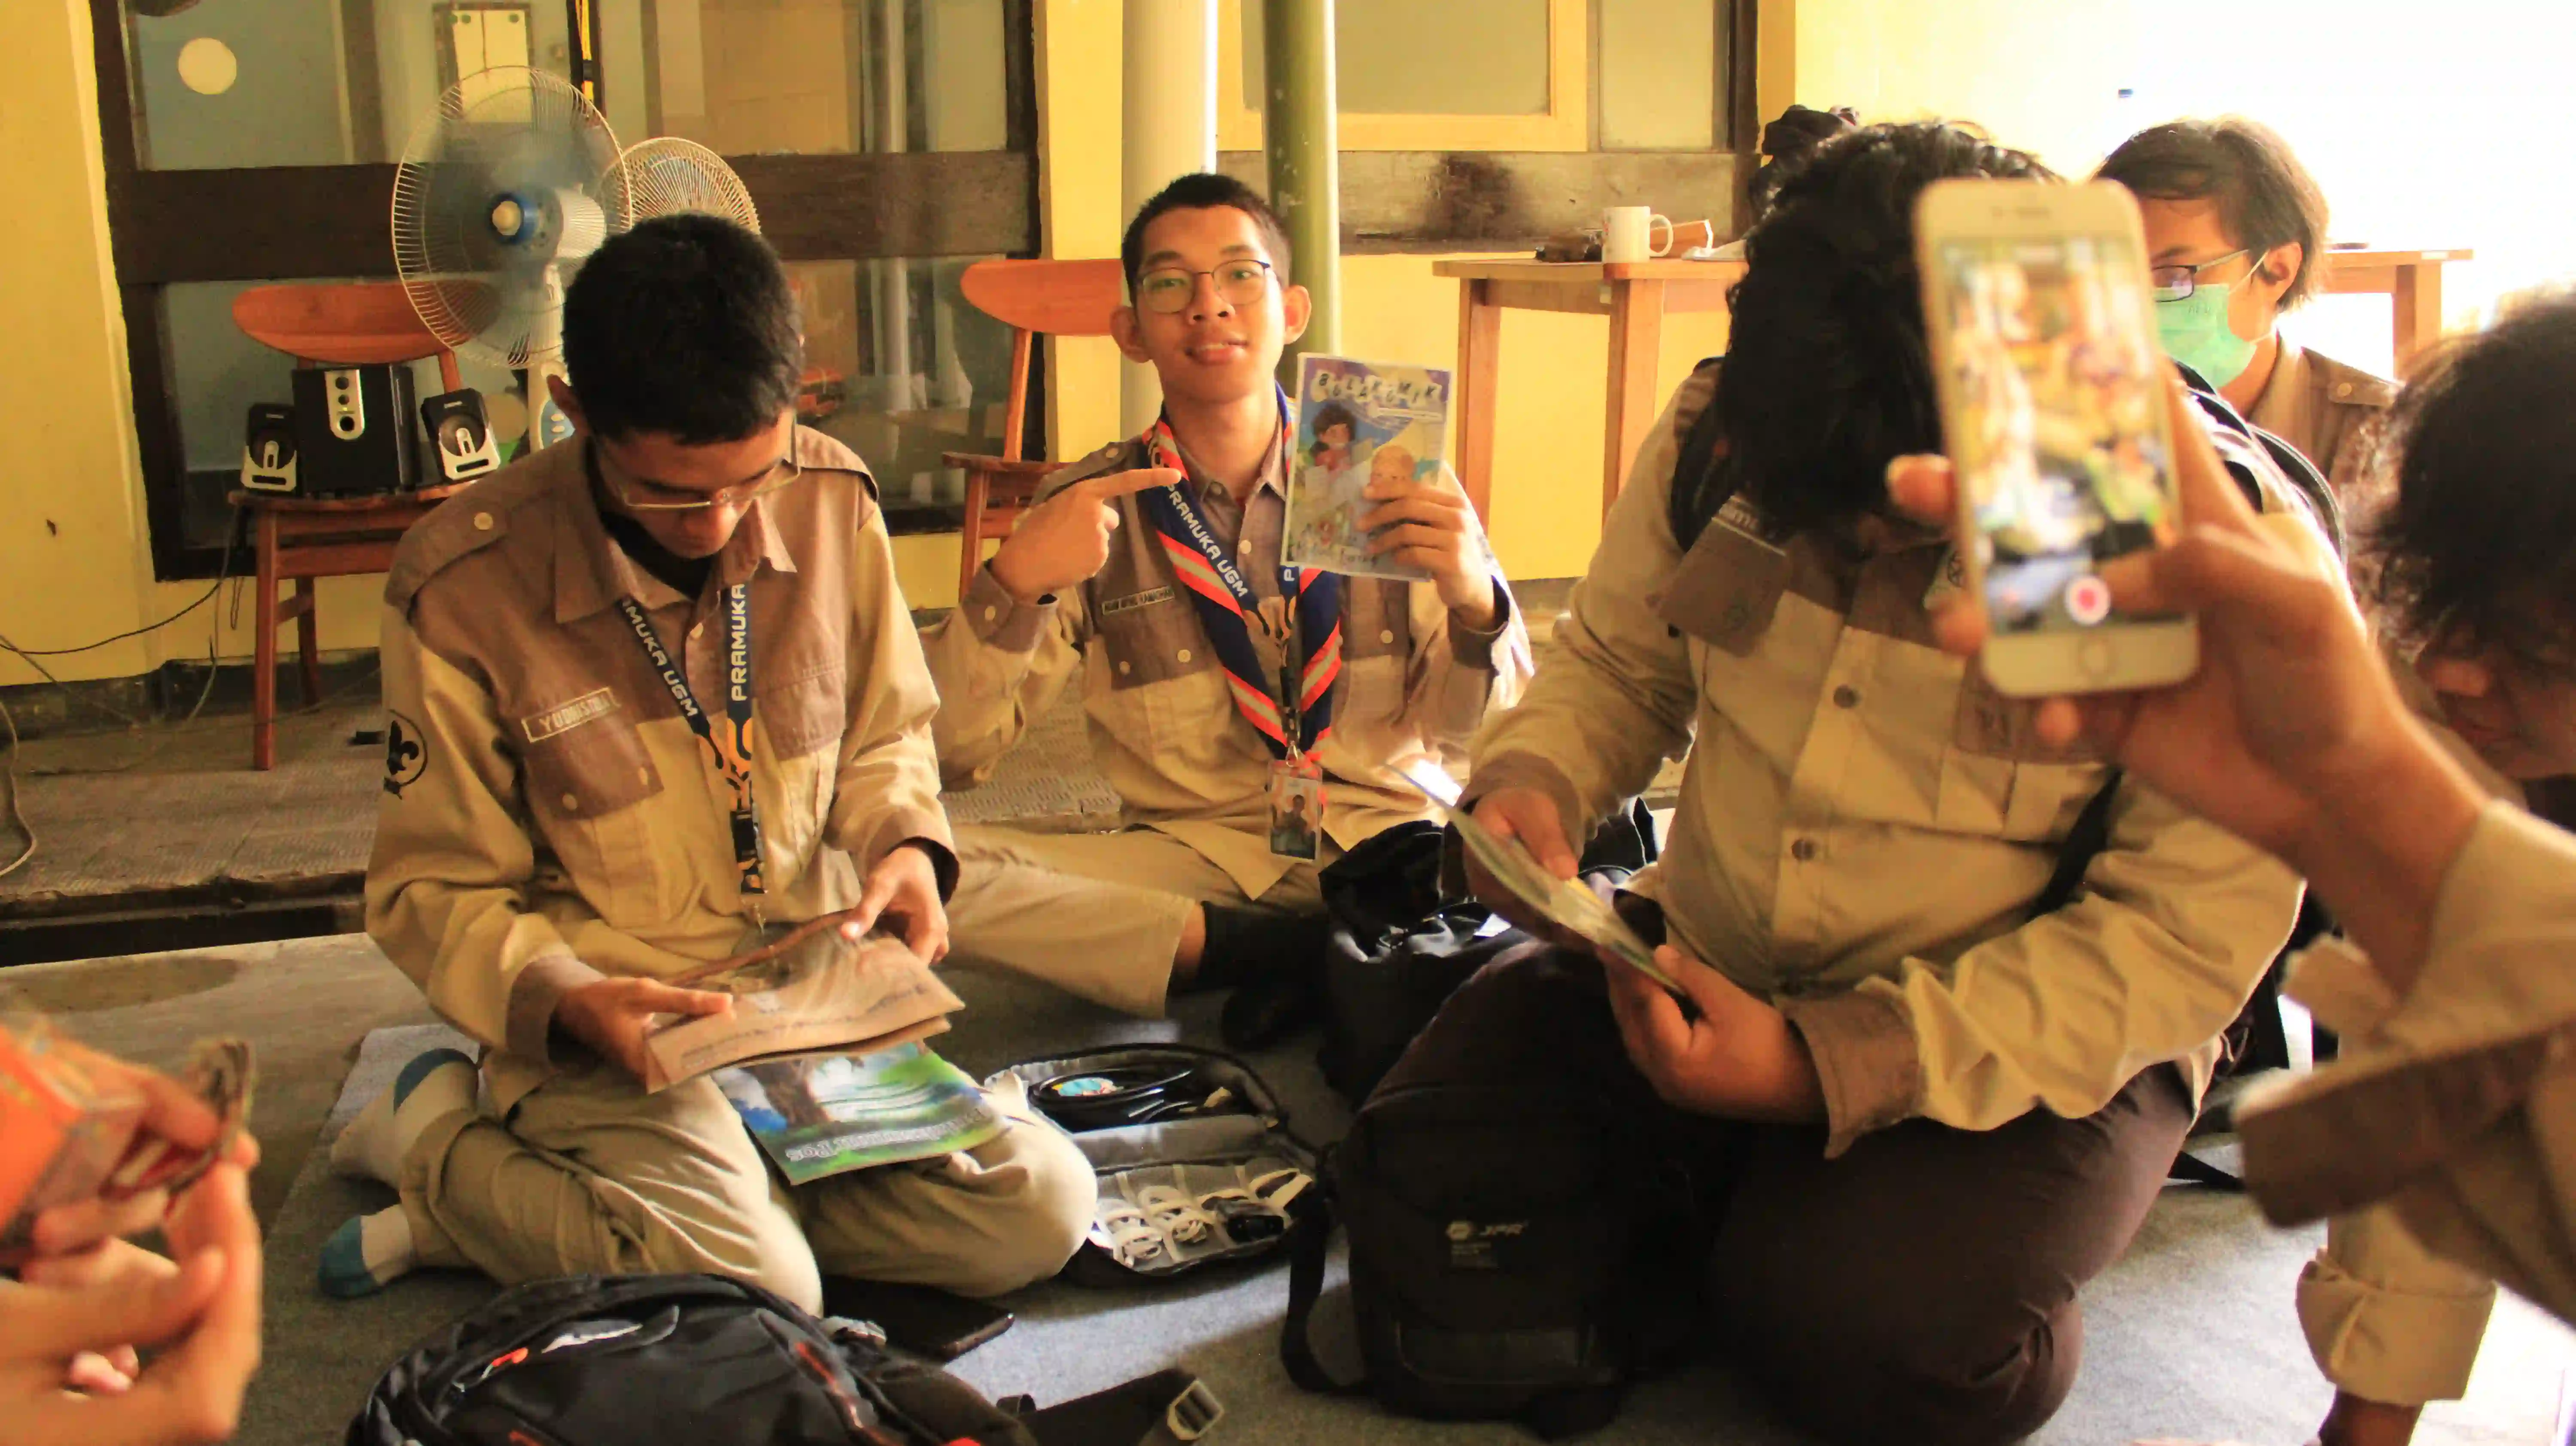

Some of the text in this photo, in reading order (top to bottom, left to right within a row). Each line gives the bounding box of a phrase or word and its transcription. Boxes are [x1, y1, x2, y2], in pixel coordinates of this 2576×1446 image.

[1217, 559, 1249, 598] UGM
[731, 583, 747, 701] PRAMUKA
[663, 670, 698, 717] UGM
